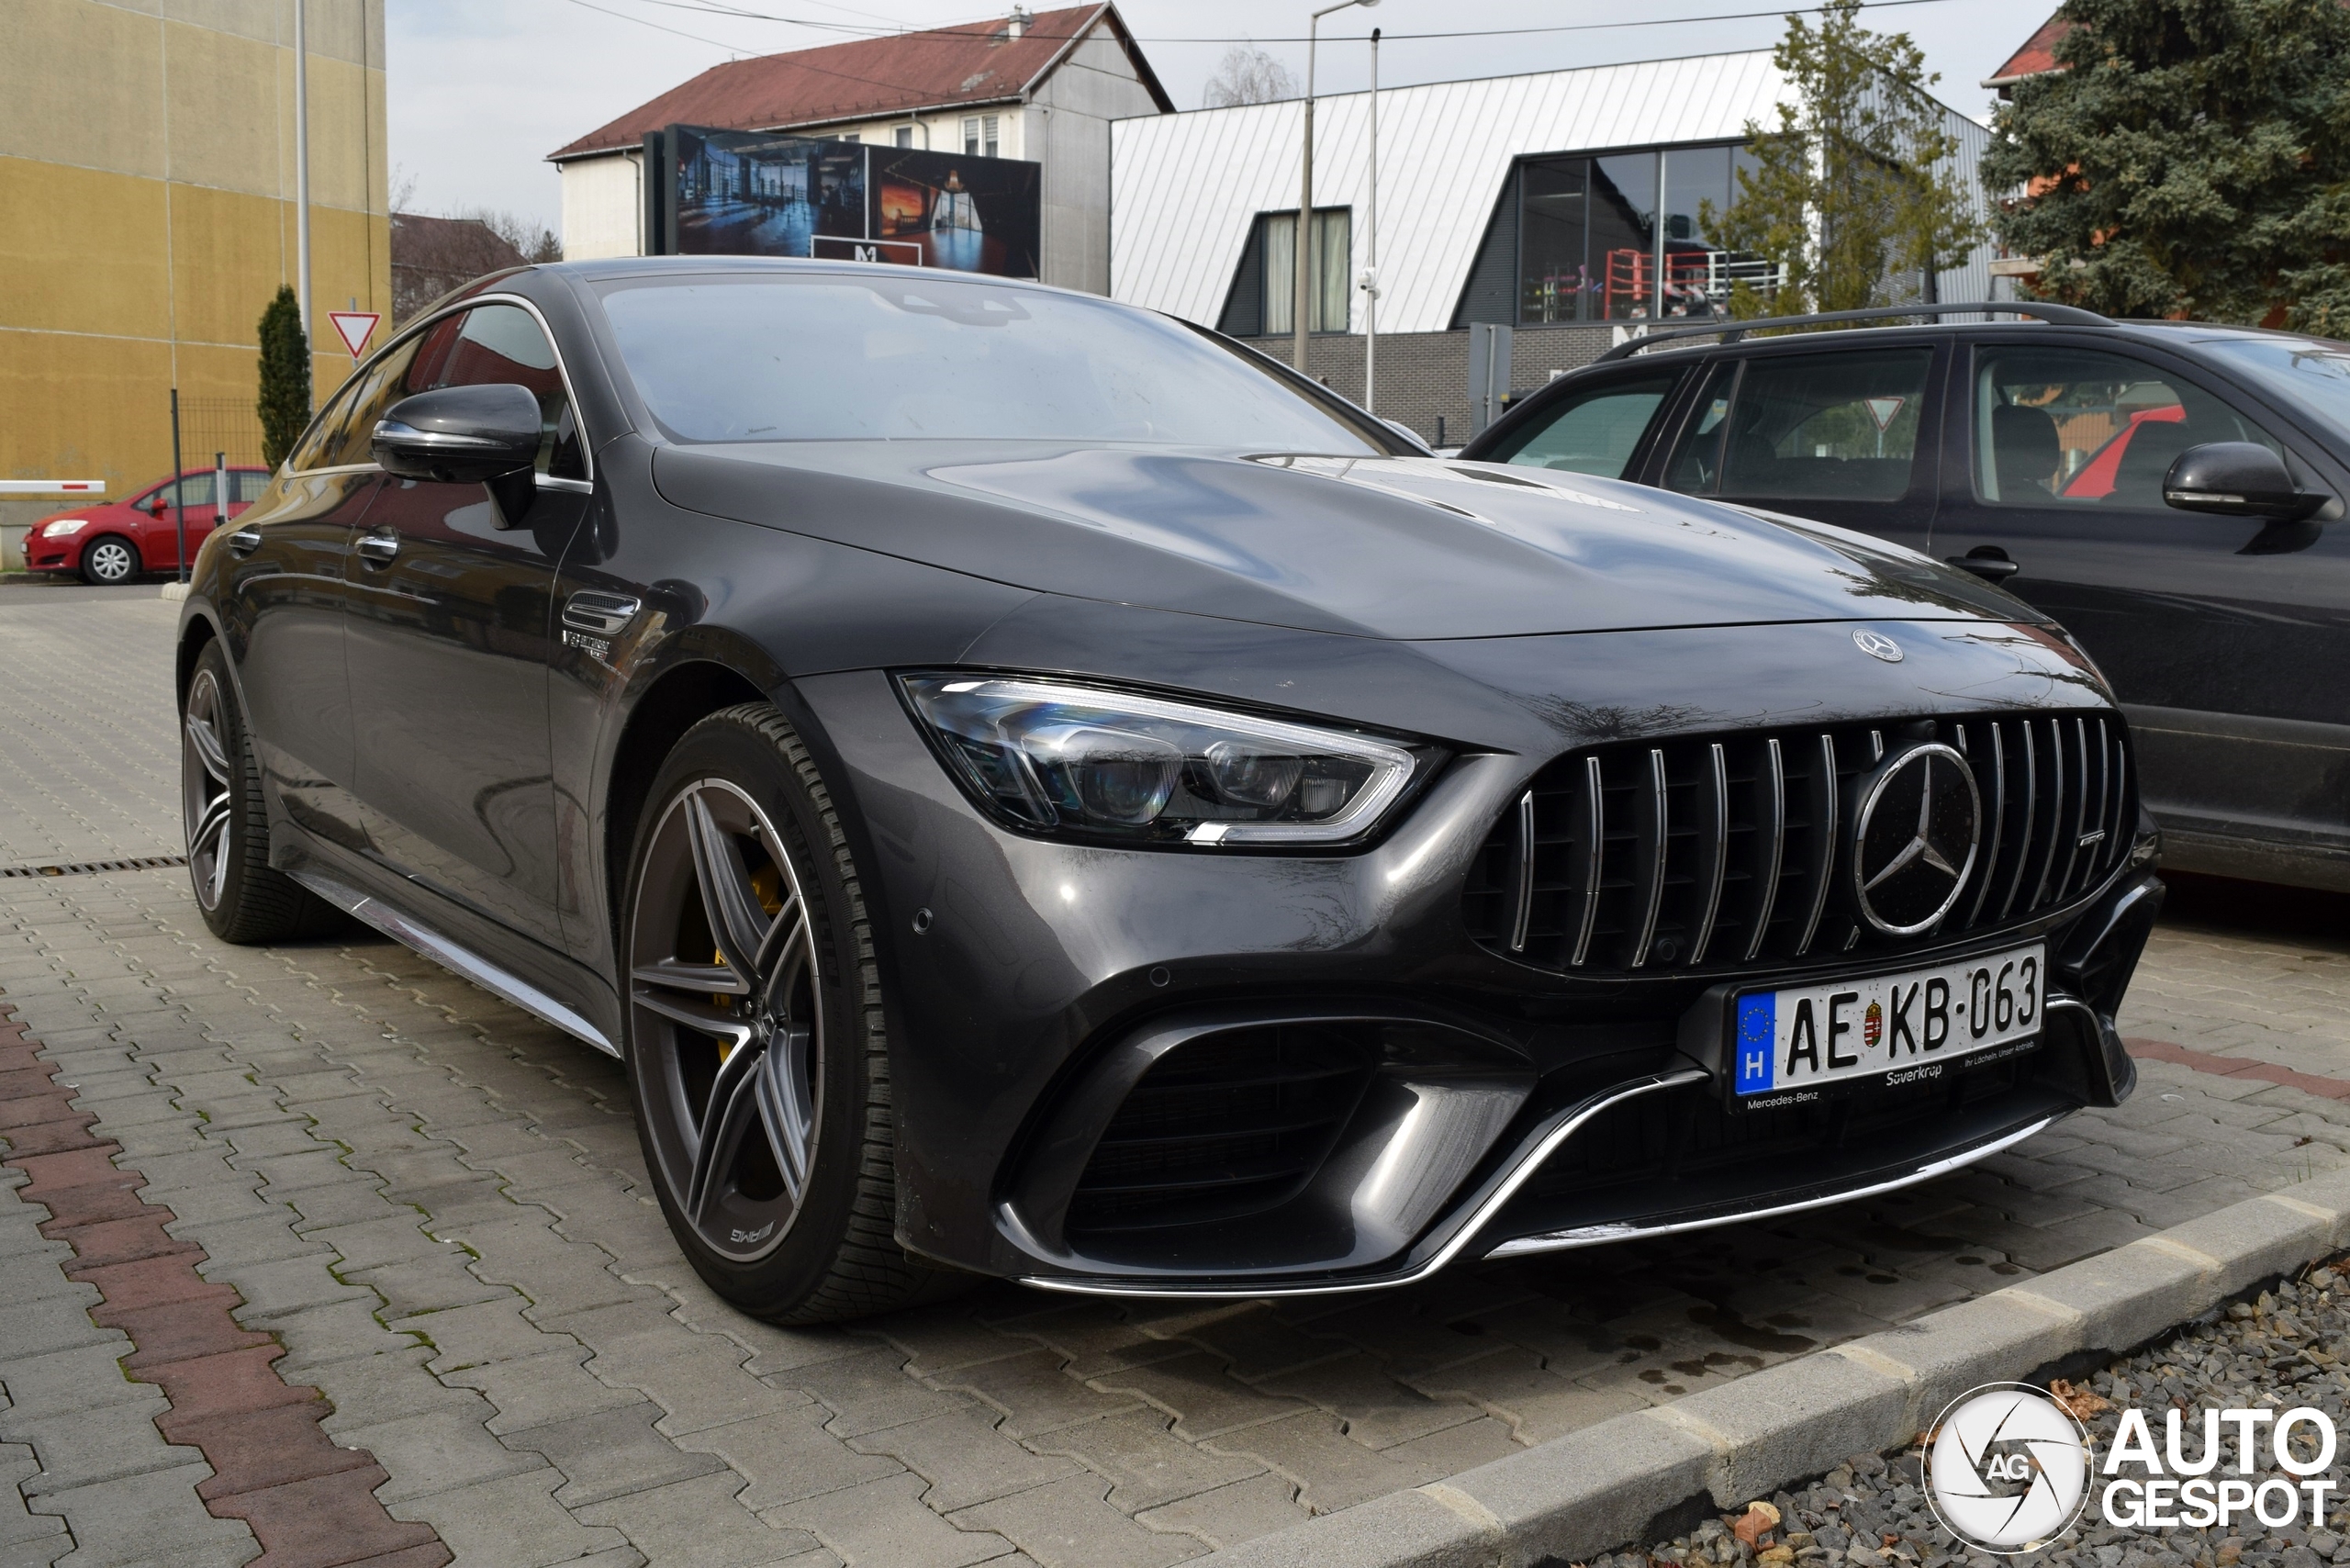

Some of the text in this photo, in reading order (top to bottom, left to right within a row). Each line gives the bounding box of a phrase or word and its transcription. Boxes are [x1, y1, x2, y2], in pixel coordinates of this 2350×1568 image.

[789, 824, 838, 977] MICHELIN
[1786, 991, 1858, 1077] AE
[1745, 1051, 1763, 1080] H
[1998, 1047, 2014, 1058] Unser
[1886, 1064, 1942, 1087] Süverkrüp
[1747, 1092, 1818, 1110] Mercedes-Benz
